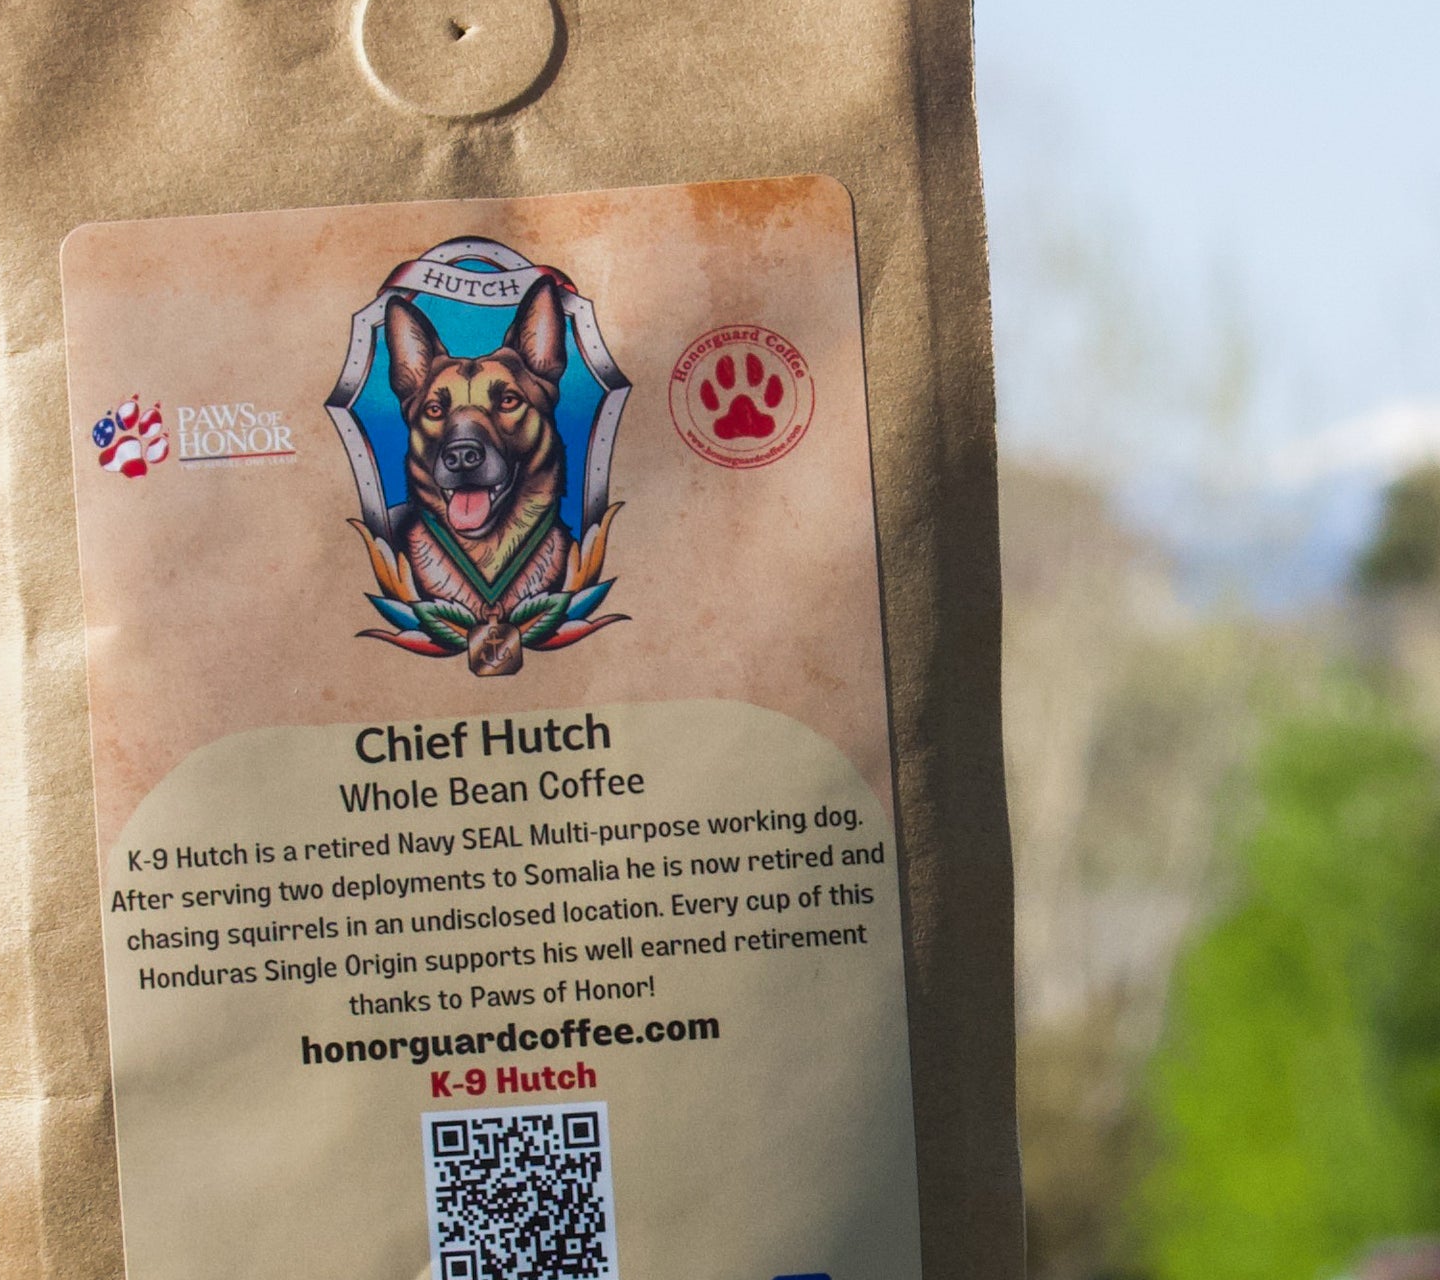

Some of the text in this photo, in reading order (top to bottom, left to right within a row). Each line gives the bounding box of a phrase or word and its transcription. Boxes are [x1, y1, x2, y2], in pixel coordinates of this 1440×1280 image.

[423, 268, 519, 297] HUTCH
[674, 330, 805, 382] Honorguard Coffee
[178, 402, 282, 432] PAWS OF
[179, 425, 295, 457] HONOR
[355, 712, 611, 764] Chief Hutch
[339, 767, 645, 813] Whole Bean Coffee
[128, 805, 863, 872] K-9 Hutch is a retired Navy SEAL Multi-purpose working dog.
[111, 841, 885, 913] After serving two deployments to Somalia he is now retired and
[127, 883, 875, 951] chasing squirrels in an undisclosed location. Every cup of this
[139, 924, 868, 990] Honduras Single Origin supports his well earned retirement
[348, 975, 655, 1016] thanks to Paws of Honor!
[301, 1017, 720, 1065] honorguardcoffee.com
[430, 1061, 597, 1098] K-9 Hutch
